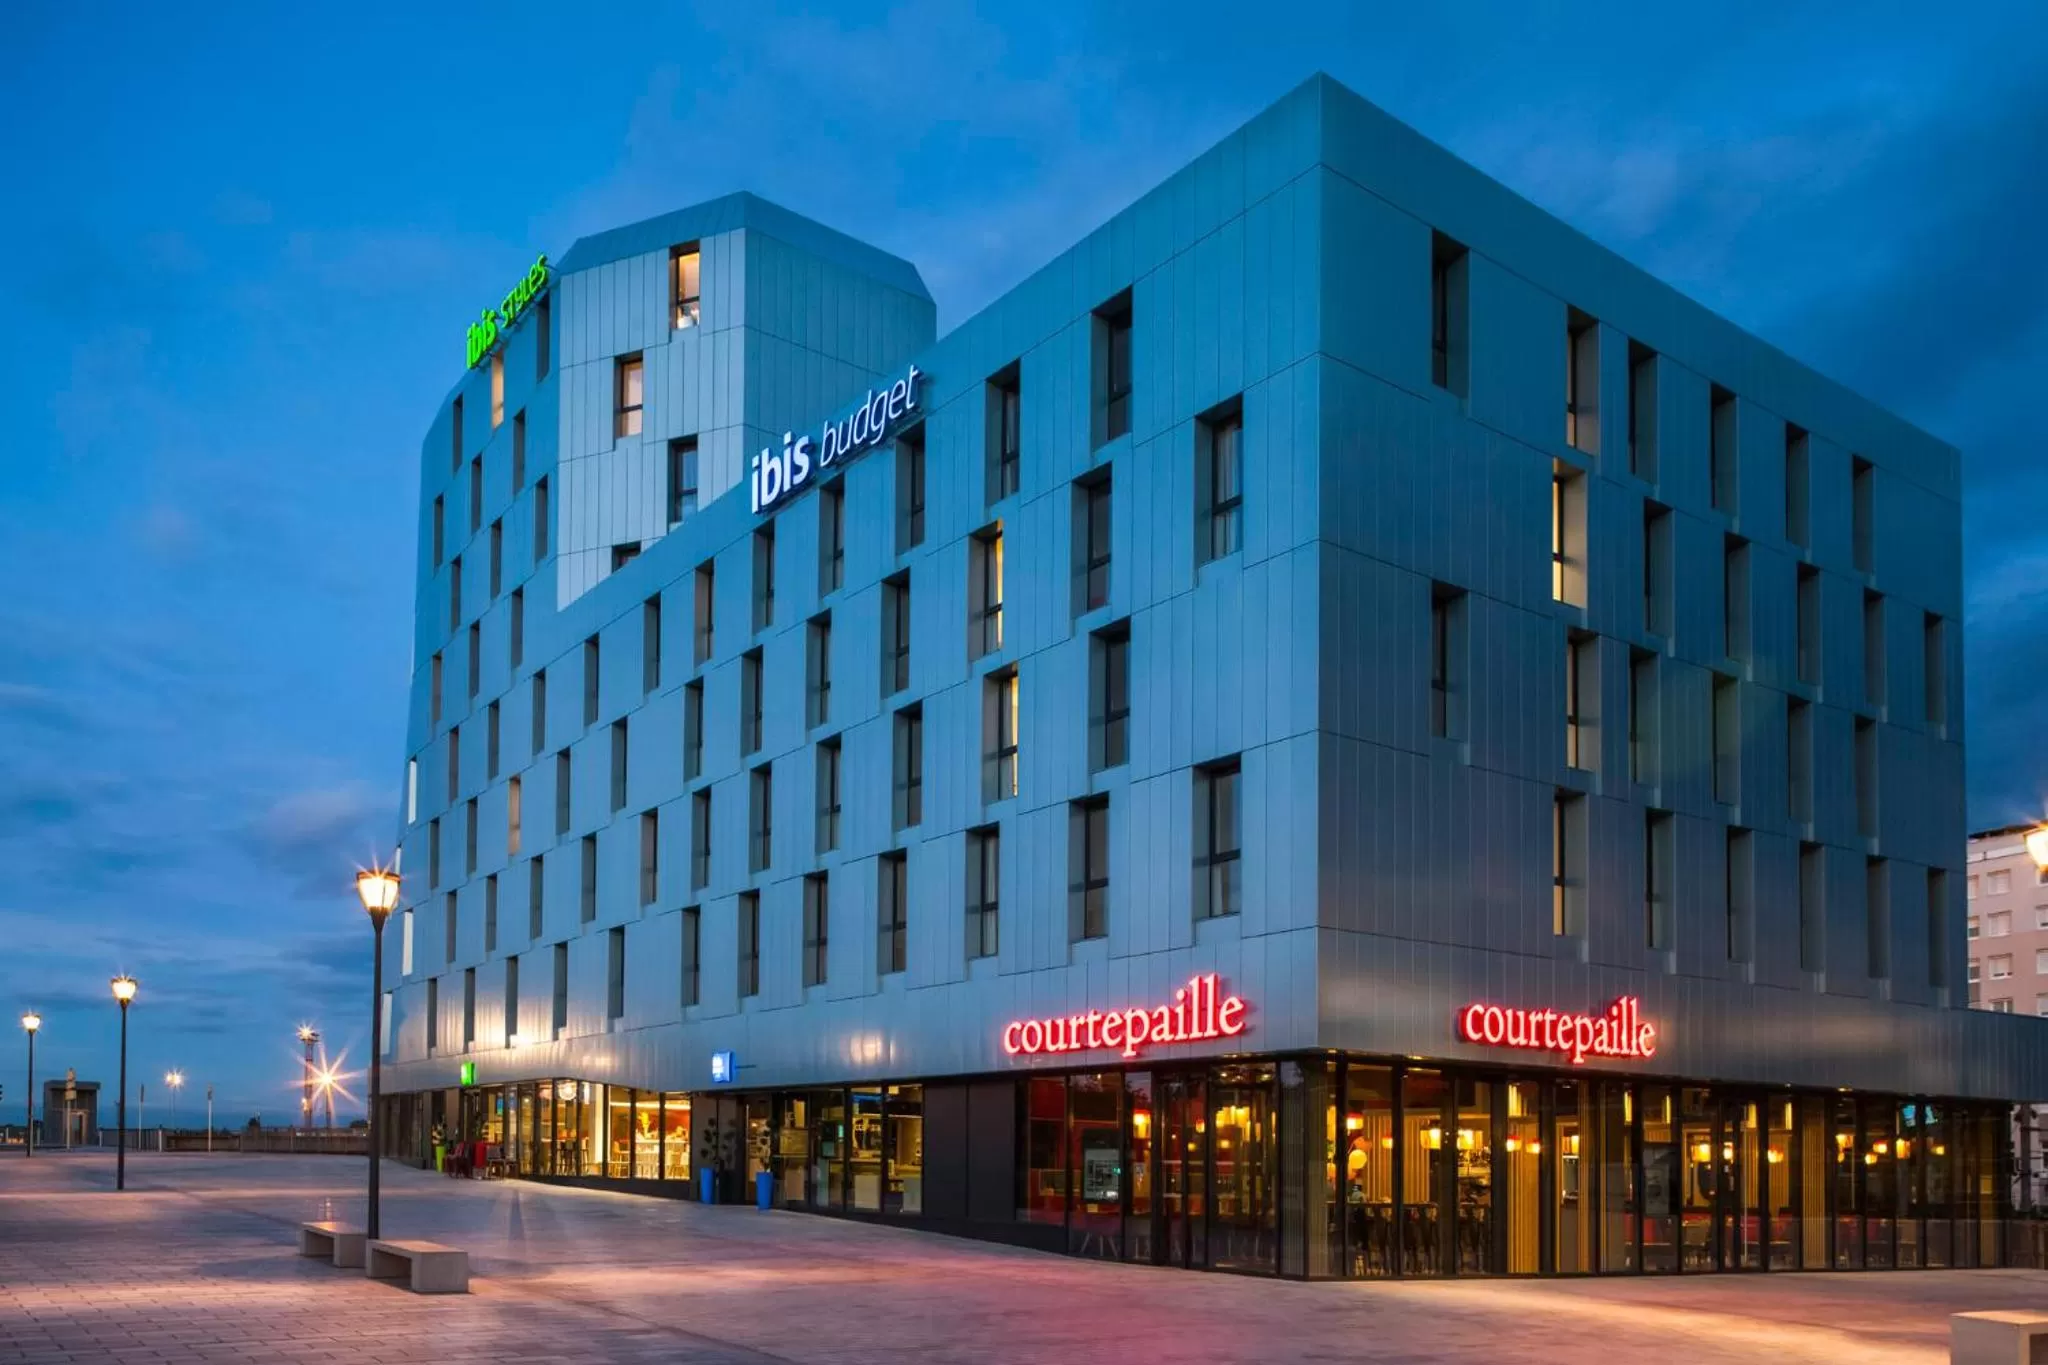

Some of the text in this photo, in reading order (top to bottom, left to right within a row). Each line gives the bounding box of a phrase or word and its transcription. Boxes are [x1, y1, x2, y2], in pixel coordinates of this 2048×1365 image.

[466, 308, 496, 368] ibis
[752, 364, 919, 514] ibis budget
[1004, 973, 1244, 1057] courtepaille
[1466, 996, 1656, 1064] courtepaille
